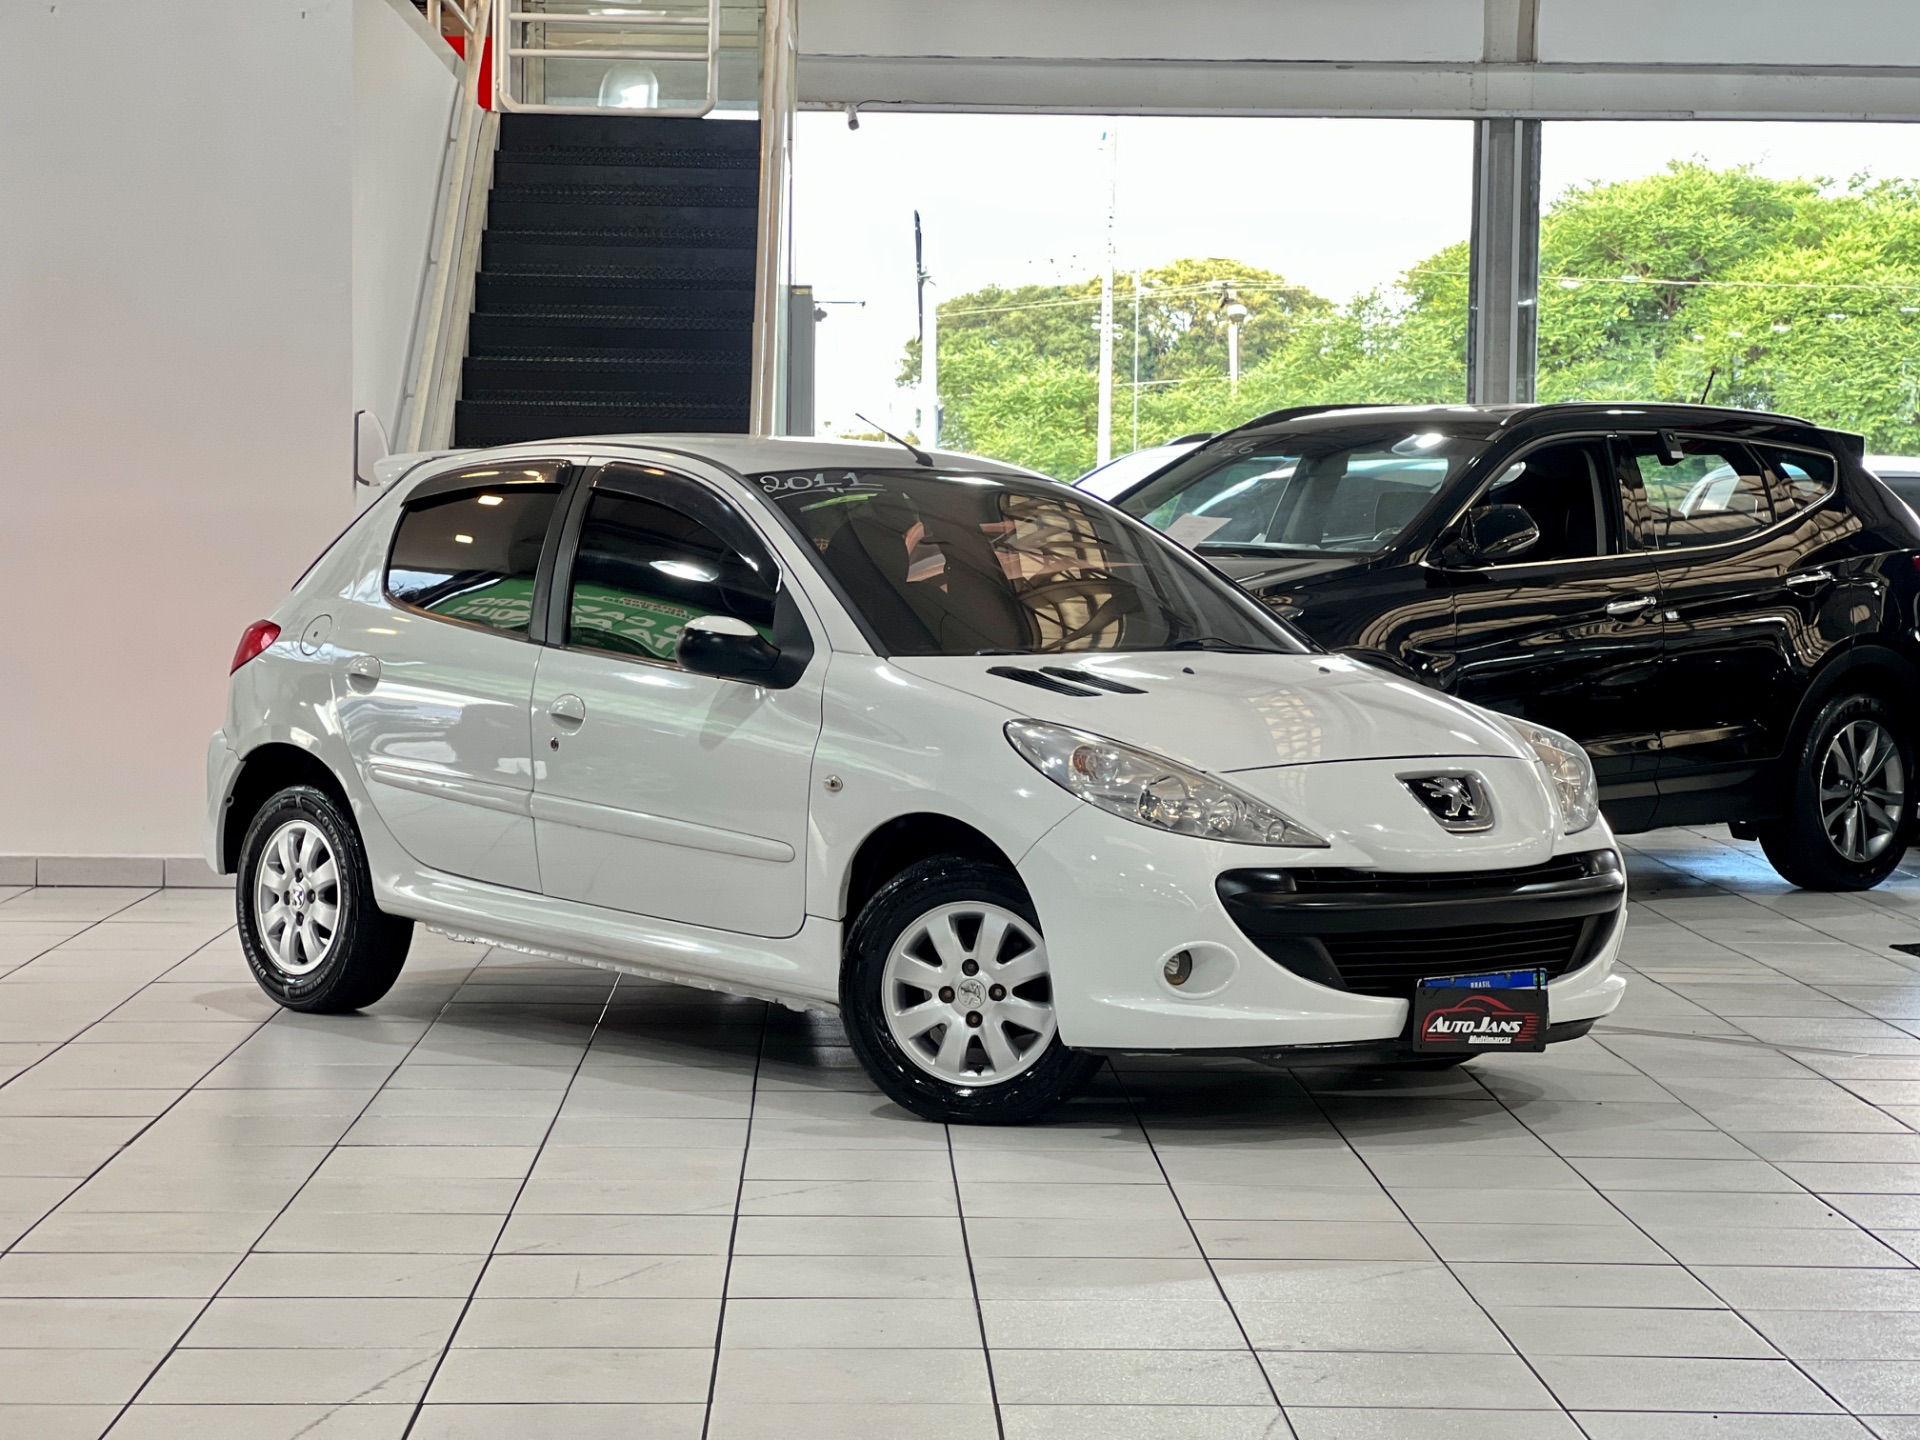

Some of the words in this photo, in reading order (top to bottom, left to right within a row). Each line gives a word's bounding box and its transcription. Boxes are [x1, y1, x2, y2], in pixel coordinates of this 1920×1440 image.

[760, 472, 883, 492] 2011
[1470, 980, 1491, 989] BRASIL
[1468, 1035, 1512, 1044] Multimarcas
